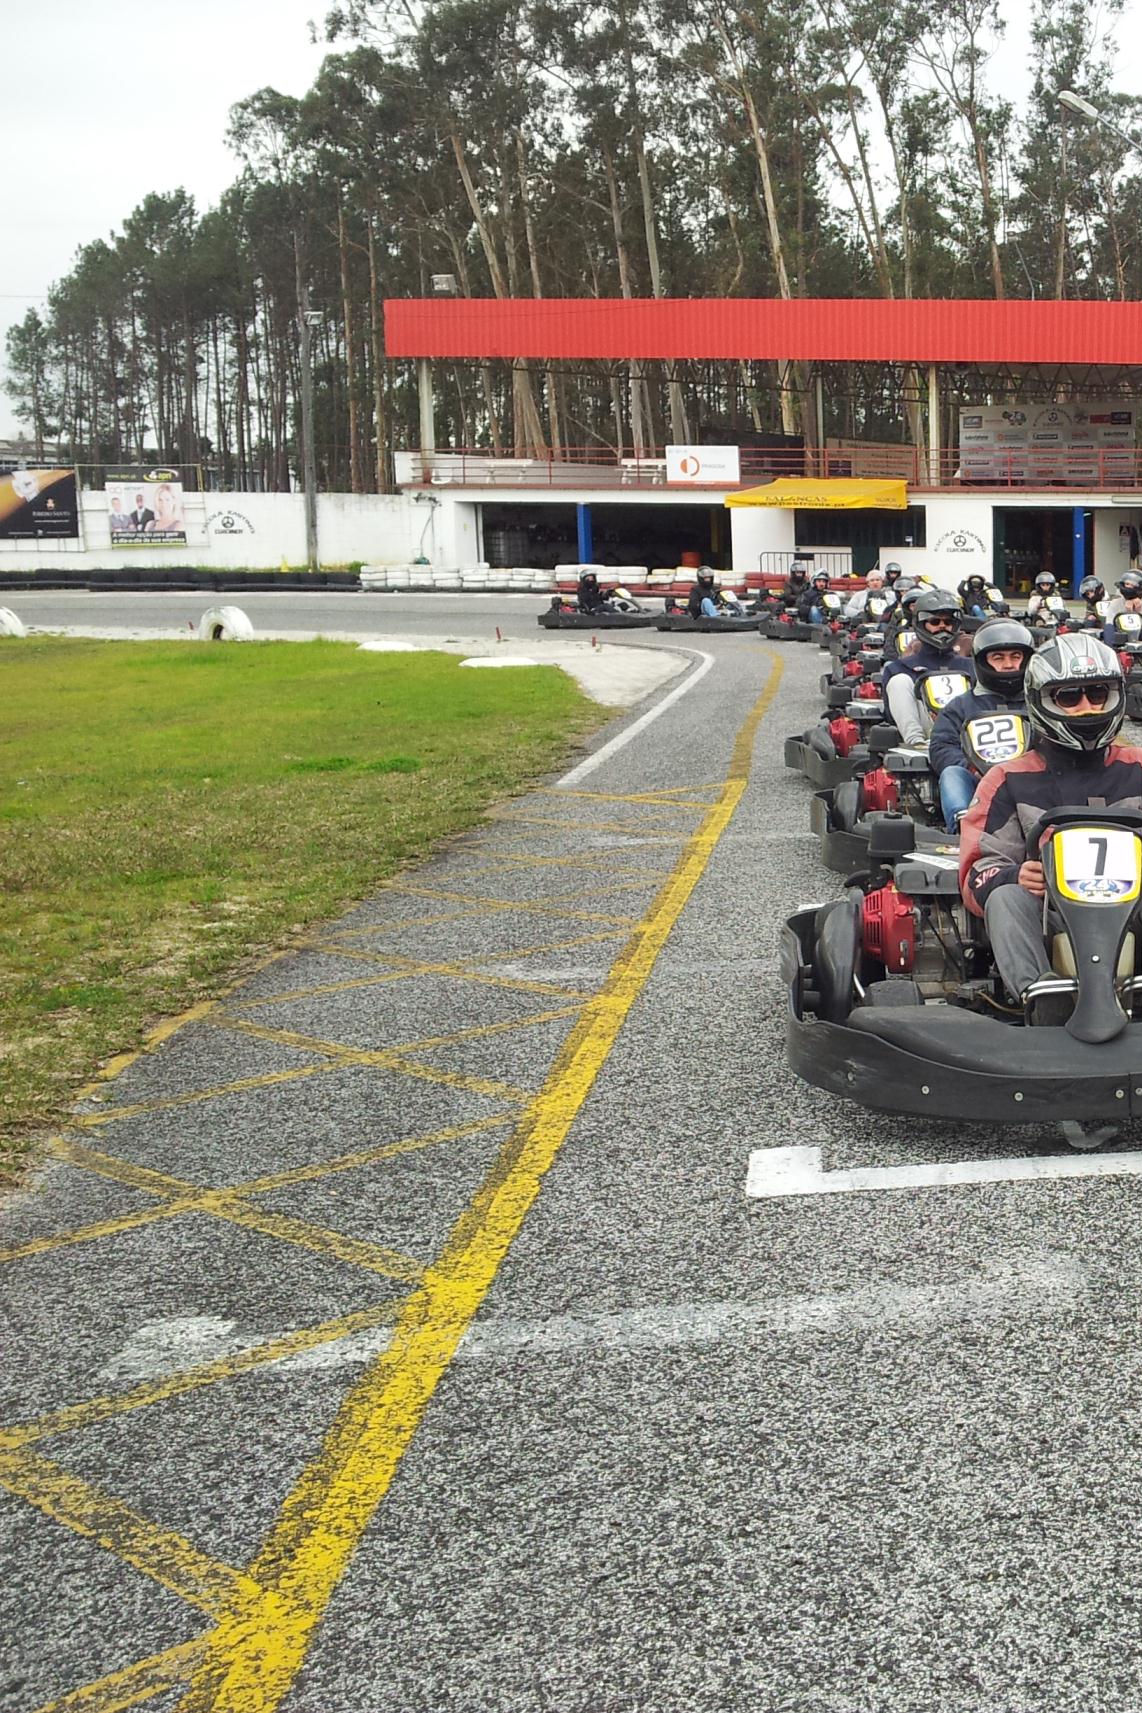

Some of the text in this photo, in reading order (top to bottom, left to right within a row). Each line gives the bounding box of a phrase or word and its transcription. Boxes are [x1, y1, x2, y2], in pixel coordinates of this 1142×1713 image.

[941, 676, 953, 695] 3
[975, 718, 1016, 746] 22
[1088, 837, 1108, 876] 7
